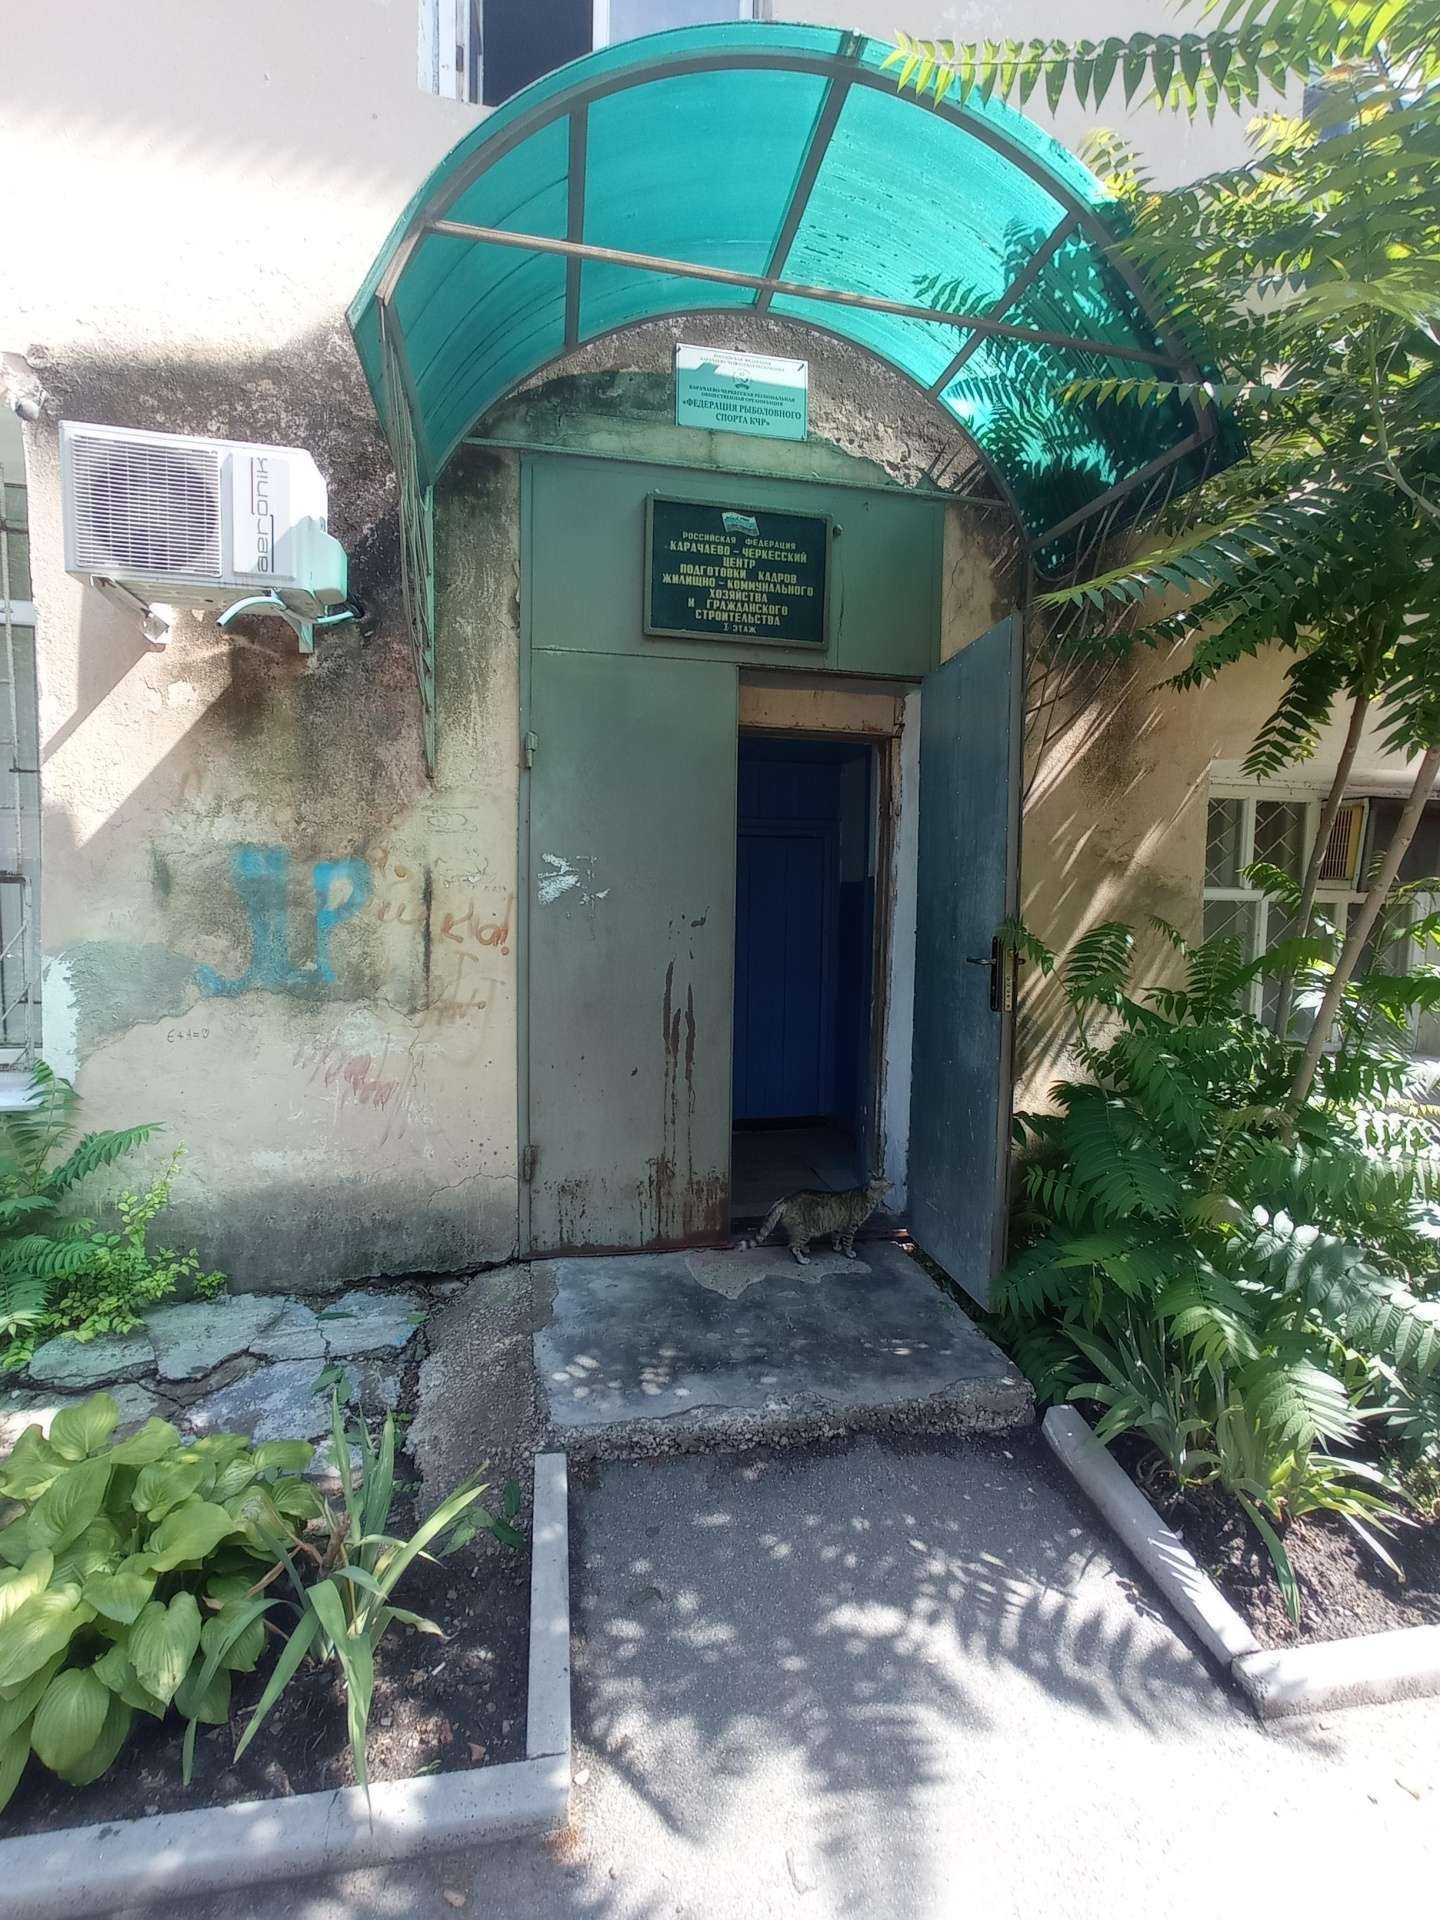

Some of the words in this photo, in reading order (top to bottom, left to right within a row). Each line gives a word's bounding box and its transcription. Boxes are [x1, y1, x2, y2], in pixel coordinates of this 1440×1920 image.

[716, 413, 748, 424] СПОРТА
[739, 405, 801, 420] РЫБОЛОВНОГО
[257, 457, 269, 572] aeronik
[682, 531, 736, 543] РОССИЙСКАЯ
[745, 538, 796, 550] ФЕДЕРАЦИЯ
[722, 557, 756, 568] ЦЕНТР
[680, 564, 747, 578] ПОДГОТОВКИ
[758, 571, 797, 583] КАДРОВ
[709, 590, 768, 603] ХОЗЯЙСТВА
[688, 598, 695, 608] И
[706, 599, 788, 615] ГРАЖДАНСКОГО
[696, 610, 781, 625] СТРОИТЕЛЬСТВА
[732, 624, 757, 633] ЭТАЖ
